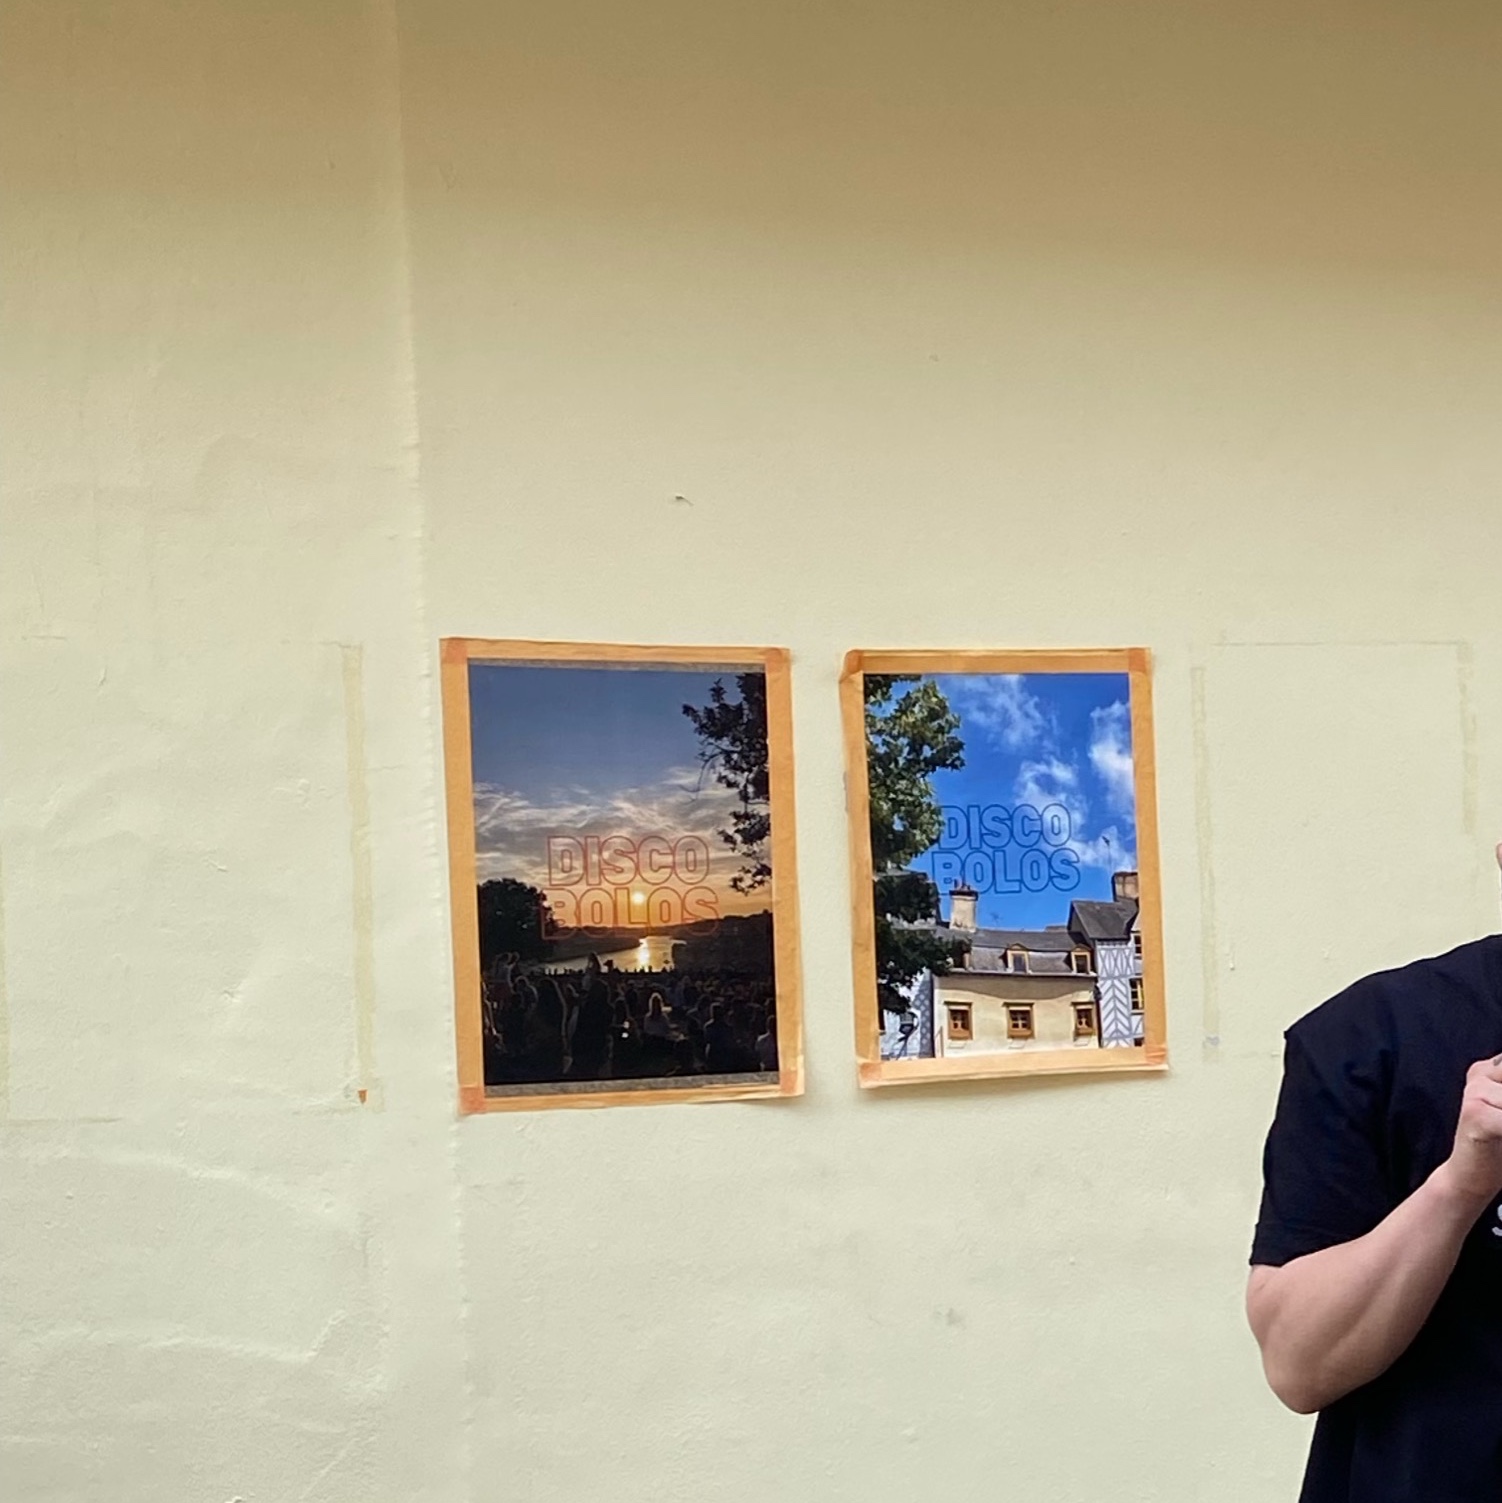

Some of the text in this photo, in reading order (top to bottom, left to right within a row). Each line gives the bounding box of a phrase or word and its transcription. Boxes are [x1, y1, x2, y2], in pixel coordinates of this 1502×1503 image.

[937, 803, 1071, 850] DISCO
[547, 835, 710, 887] DISCO
[931, 848, 1081, 896] BOLOS
[541, 886, 720, 940] BOLOS
